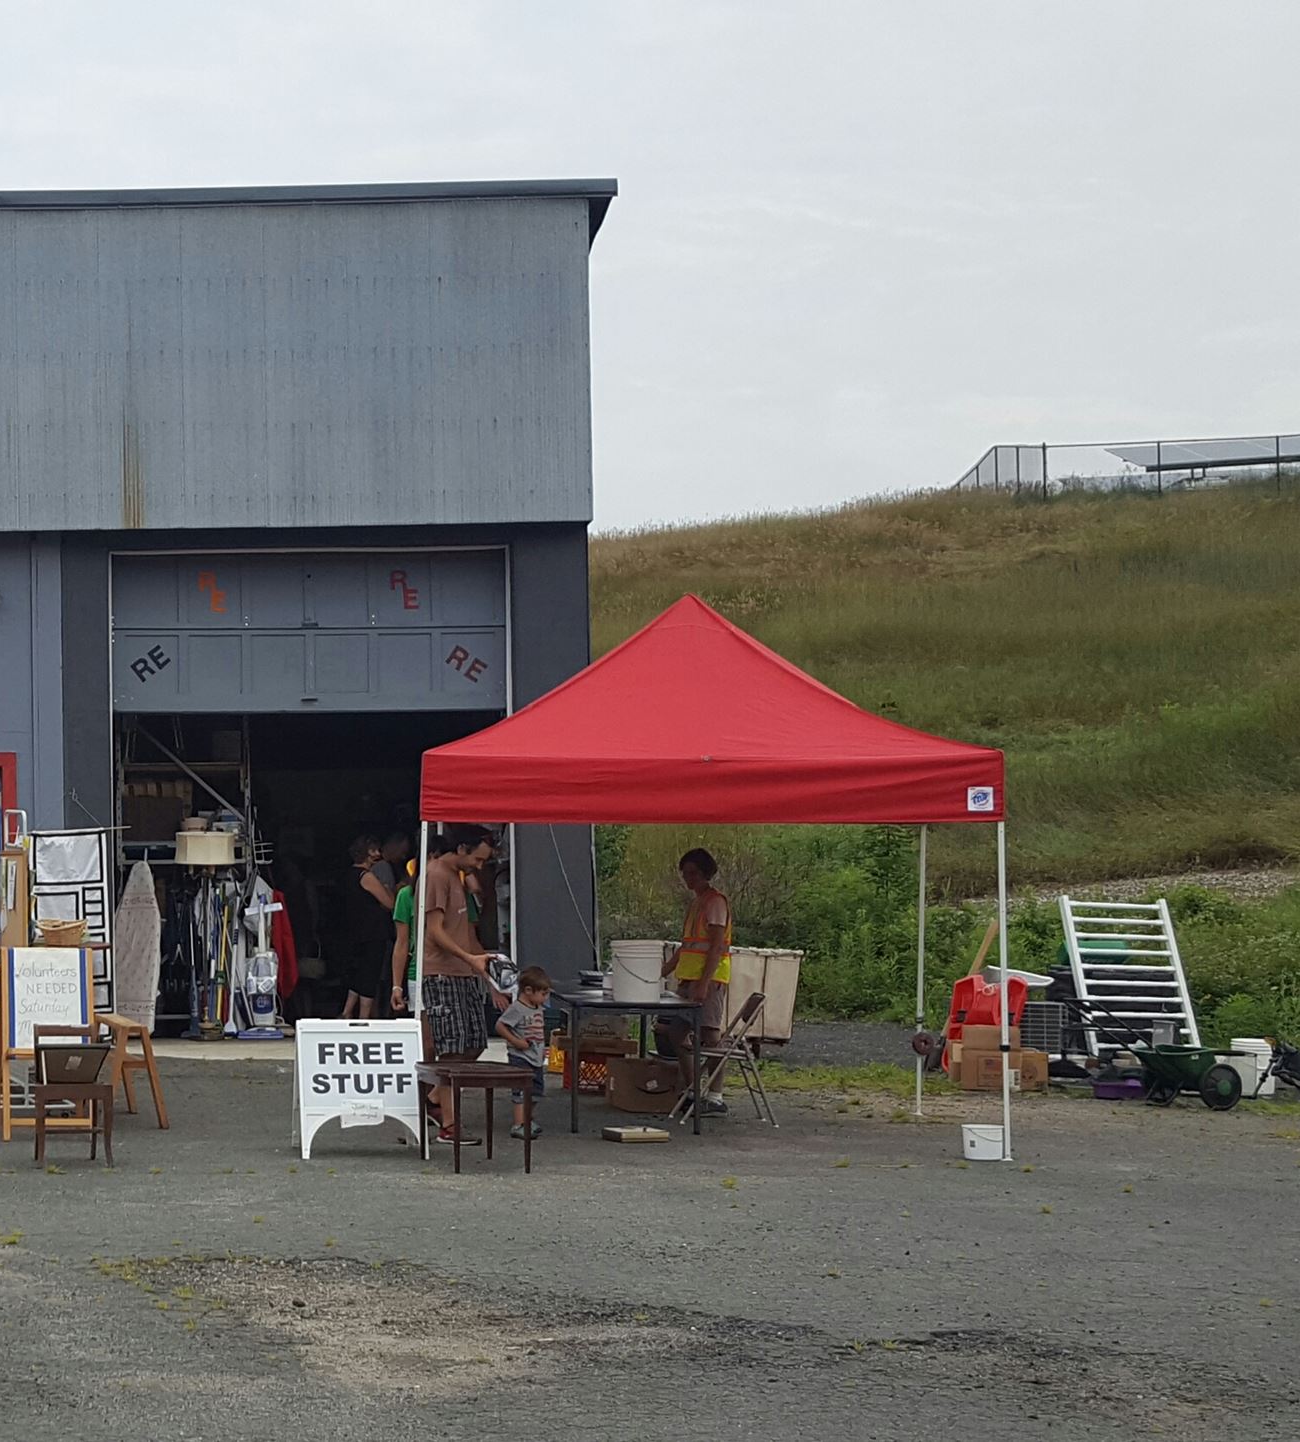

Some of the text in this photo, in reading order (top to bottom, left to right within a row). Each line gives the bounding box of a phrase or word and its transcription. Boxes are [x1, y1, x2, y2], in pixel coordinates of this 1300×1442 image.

[198, 570, 227, 613] RE
[390, 570, 419, 610] RE
[130, 645, 171, 682] RE
[445, 645, 488, 683] RE
[15, 962, 77, 978] Volunteers
[26, 983, 77, 994] NEEDED
[19, 999, 68, 1017] Saturday
[318, 1043, 404, 1064] FREE
[312, 1073, 412, 1094] STUFF
